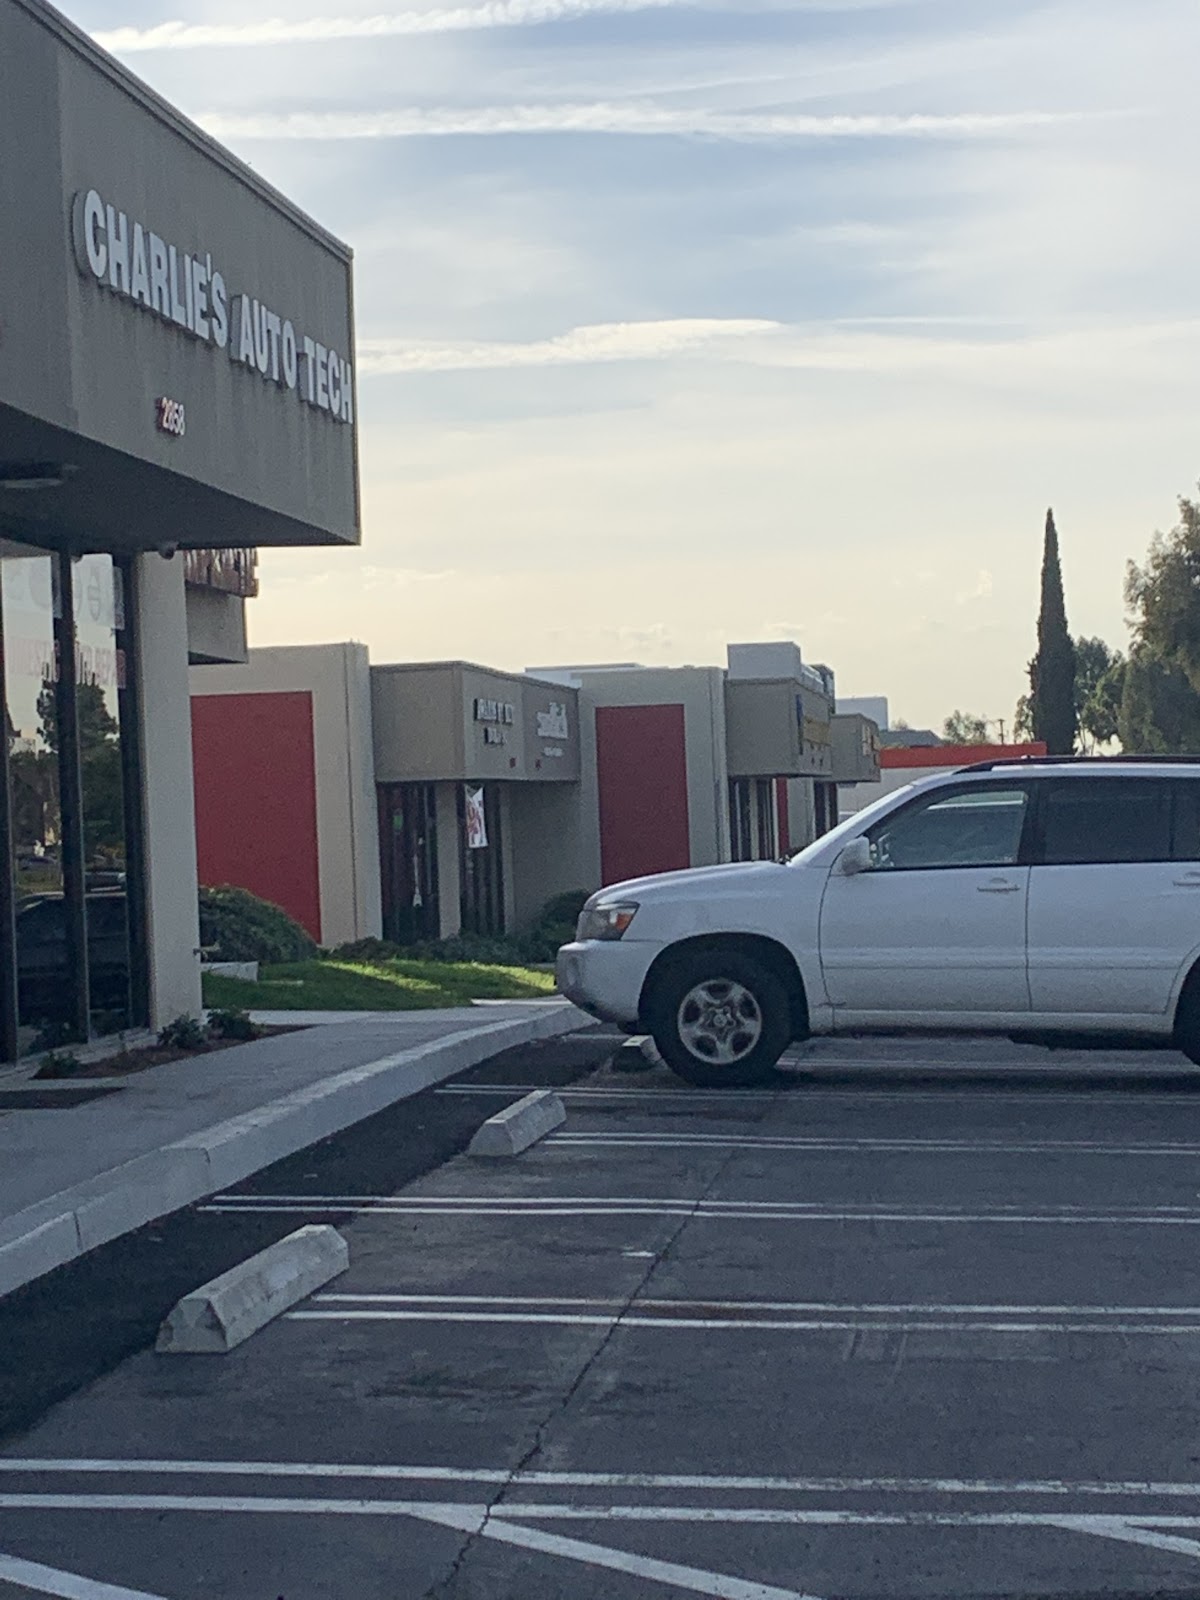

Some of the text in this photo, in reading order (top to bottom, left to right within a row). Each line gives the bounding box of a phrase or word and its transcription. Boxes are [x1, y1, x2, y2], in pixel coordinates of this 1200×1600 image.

[81, 189, 353, 424] CHARLIE'S AUTO TECH
